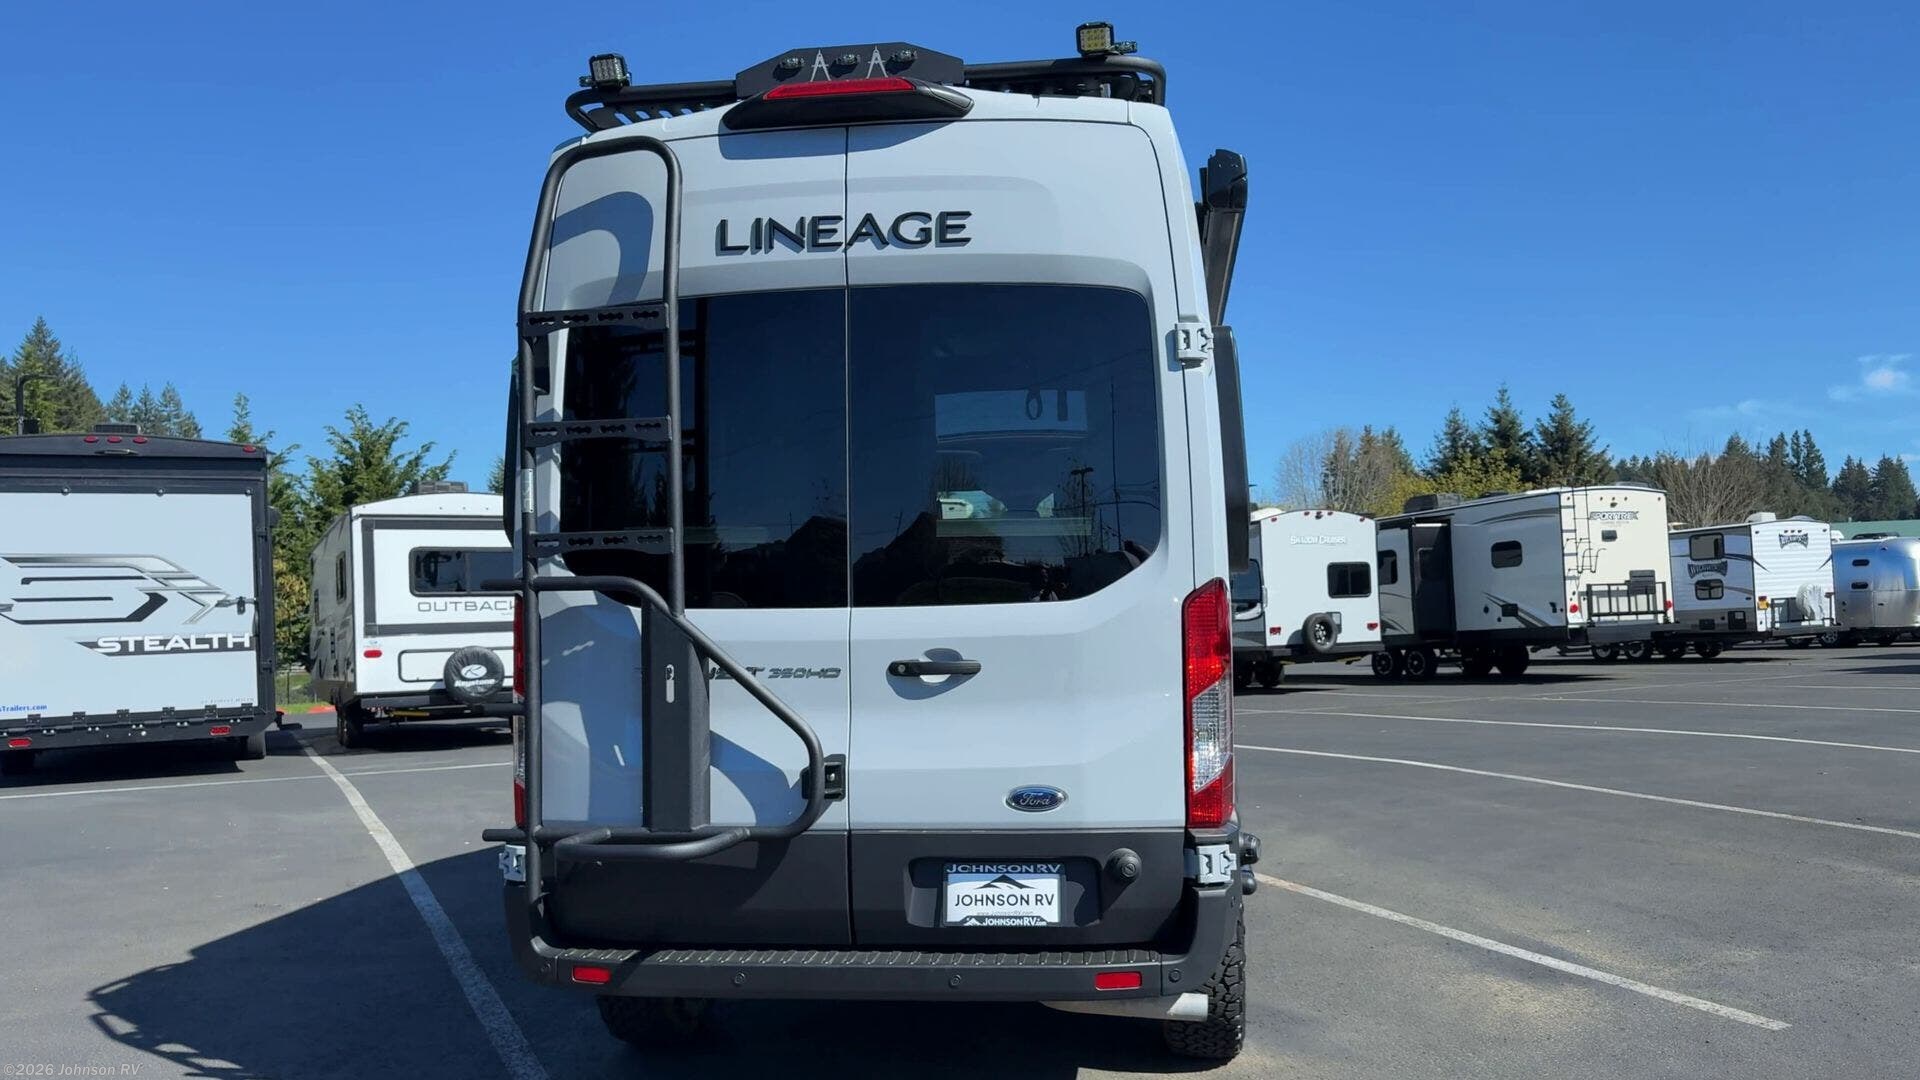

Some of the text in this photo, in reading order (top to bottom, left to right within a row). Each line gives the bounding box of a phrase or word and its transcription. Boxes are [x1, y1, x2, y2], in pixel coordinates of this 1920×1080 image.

[715, 210, 972, 257] LINEAGE
[95, 632, 251, 653] STEALTH
[768, 667, 841, 679] 350HD
[1020, 792, 1052, 805] Ford
[946, 864, 1061, 873] JOHNSON RV
[955, 894, 1055, 906] JOHNSON RV
